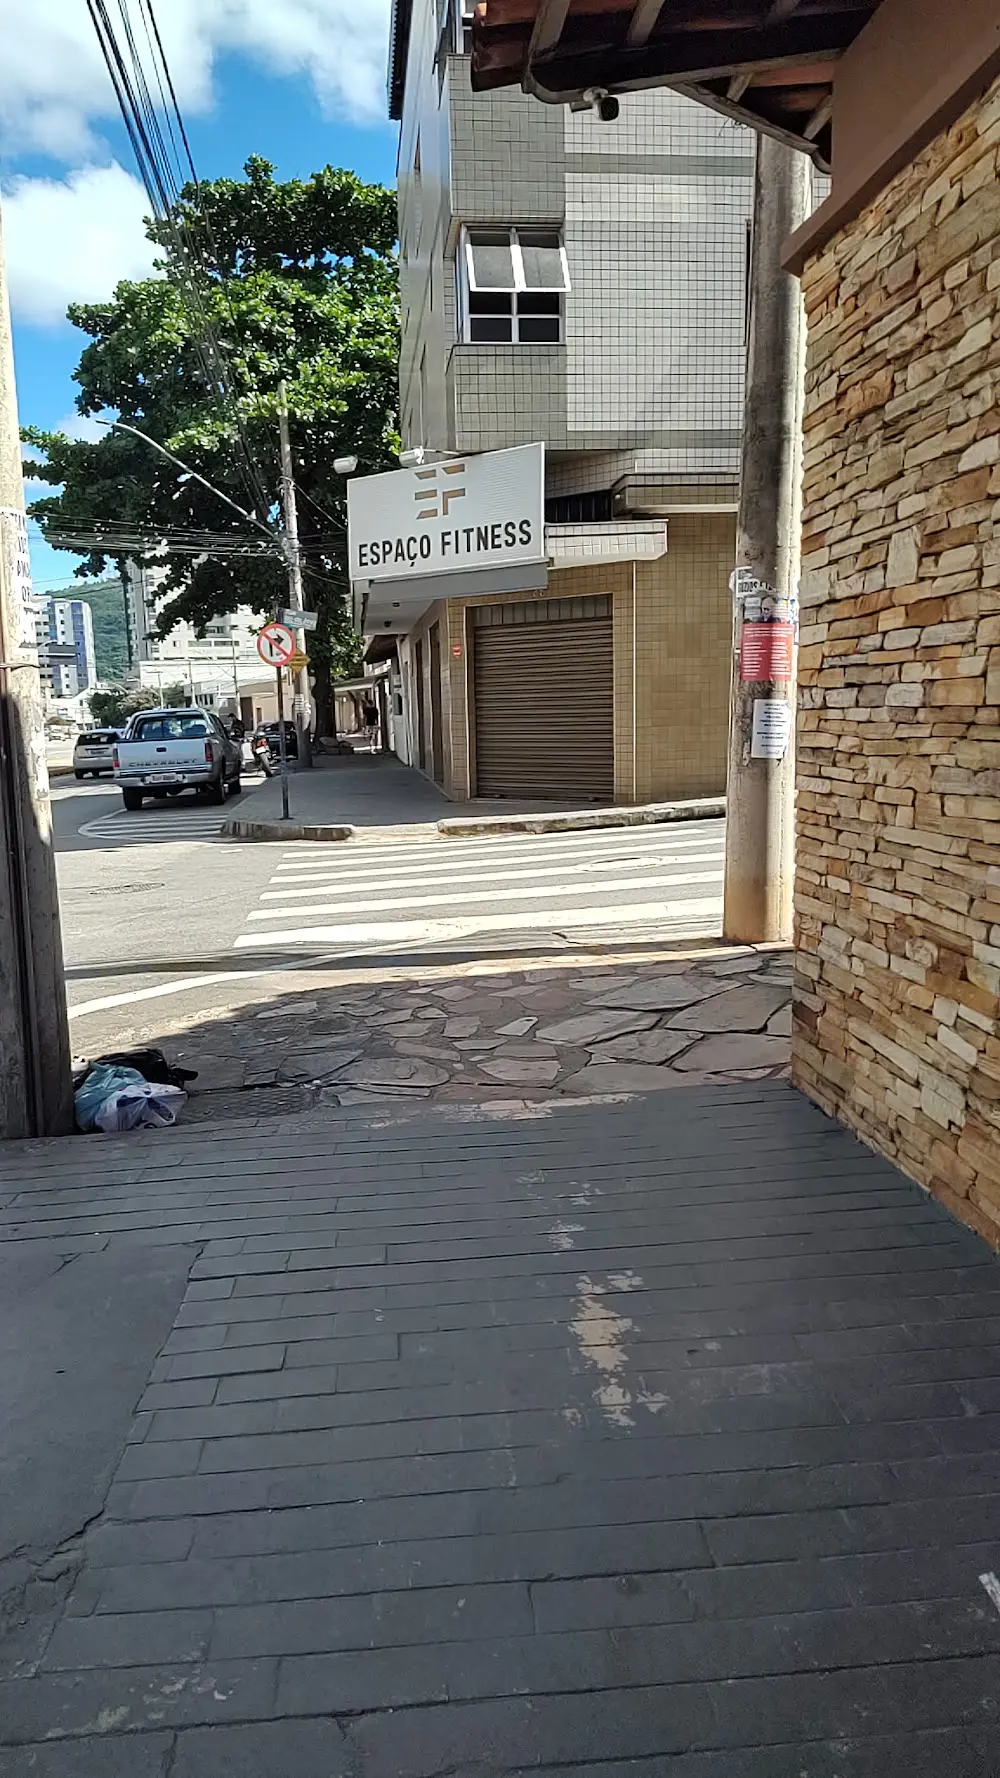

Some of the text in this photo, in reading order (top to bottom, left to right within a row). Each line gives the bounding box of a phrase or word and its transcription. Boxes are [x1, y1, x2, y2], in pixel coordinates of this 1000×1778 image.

[358, 519, 532, 568] ESPAÇO FITNESS
[128, 758, 197, 767] CHEVROLET
